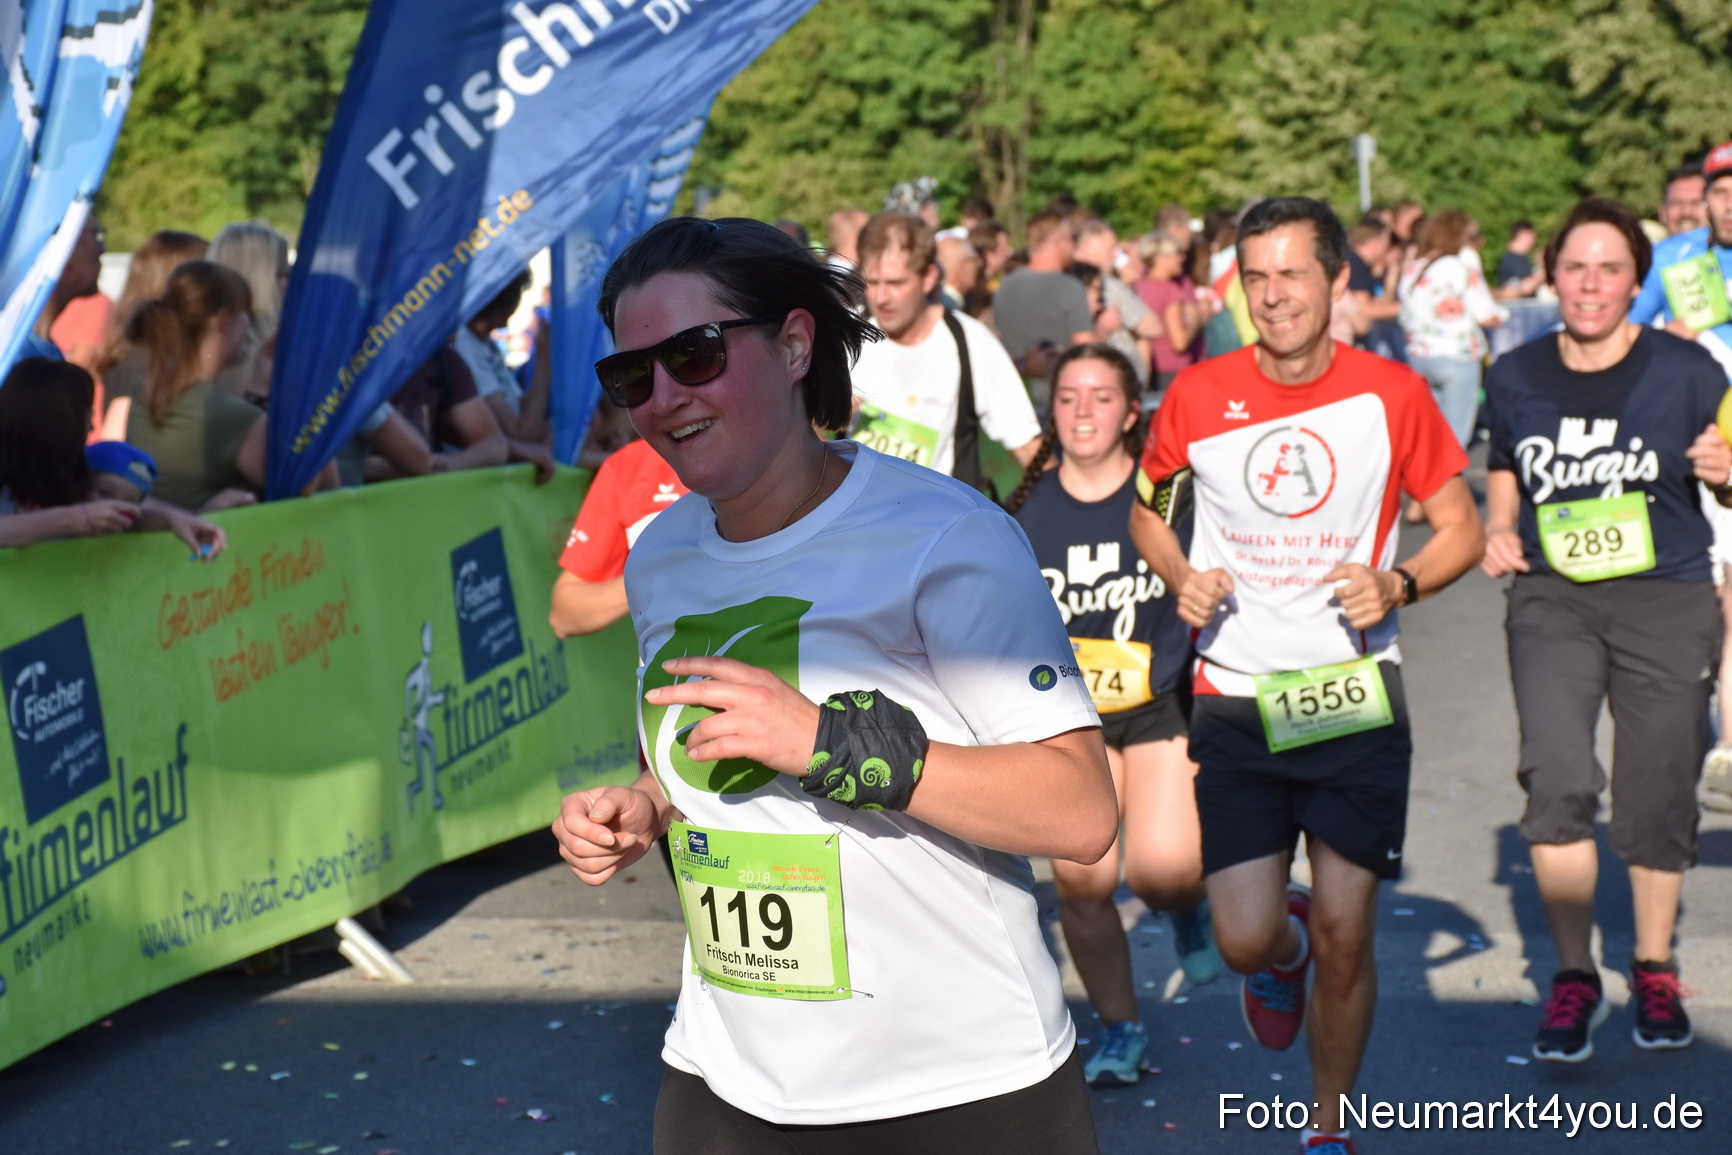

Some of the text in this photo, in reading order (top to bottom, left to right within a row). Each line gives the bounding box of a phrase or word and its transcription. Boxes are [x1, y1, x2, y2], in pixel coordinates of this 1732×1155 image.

[366, 0, 636, 209] Frisch
[1514, 436, 1660, 505] Burgis
[1564, 527, 1624, 558] 289
[1085, 668, 1124, 694] 74
[1275, 676, 1366, 721] 1556
[24, 678, 85, 729] Fischer
[0, 722, 189, 938] firmenlauf
[683, 847, 730, 869] firmenlauf
[738, 870, 771, 884] 2018
[700, 886, 794, 951] 119
[706, 944, 800, 970] Fritsch Melissa
[722, 965, 760, 981] Bionorica
[762, 971, 777, 982] SE
